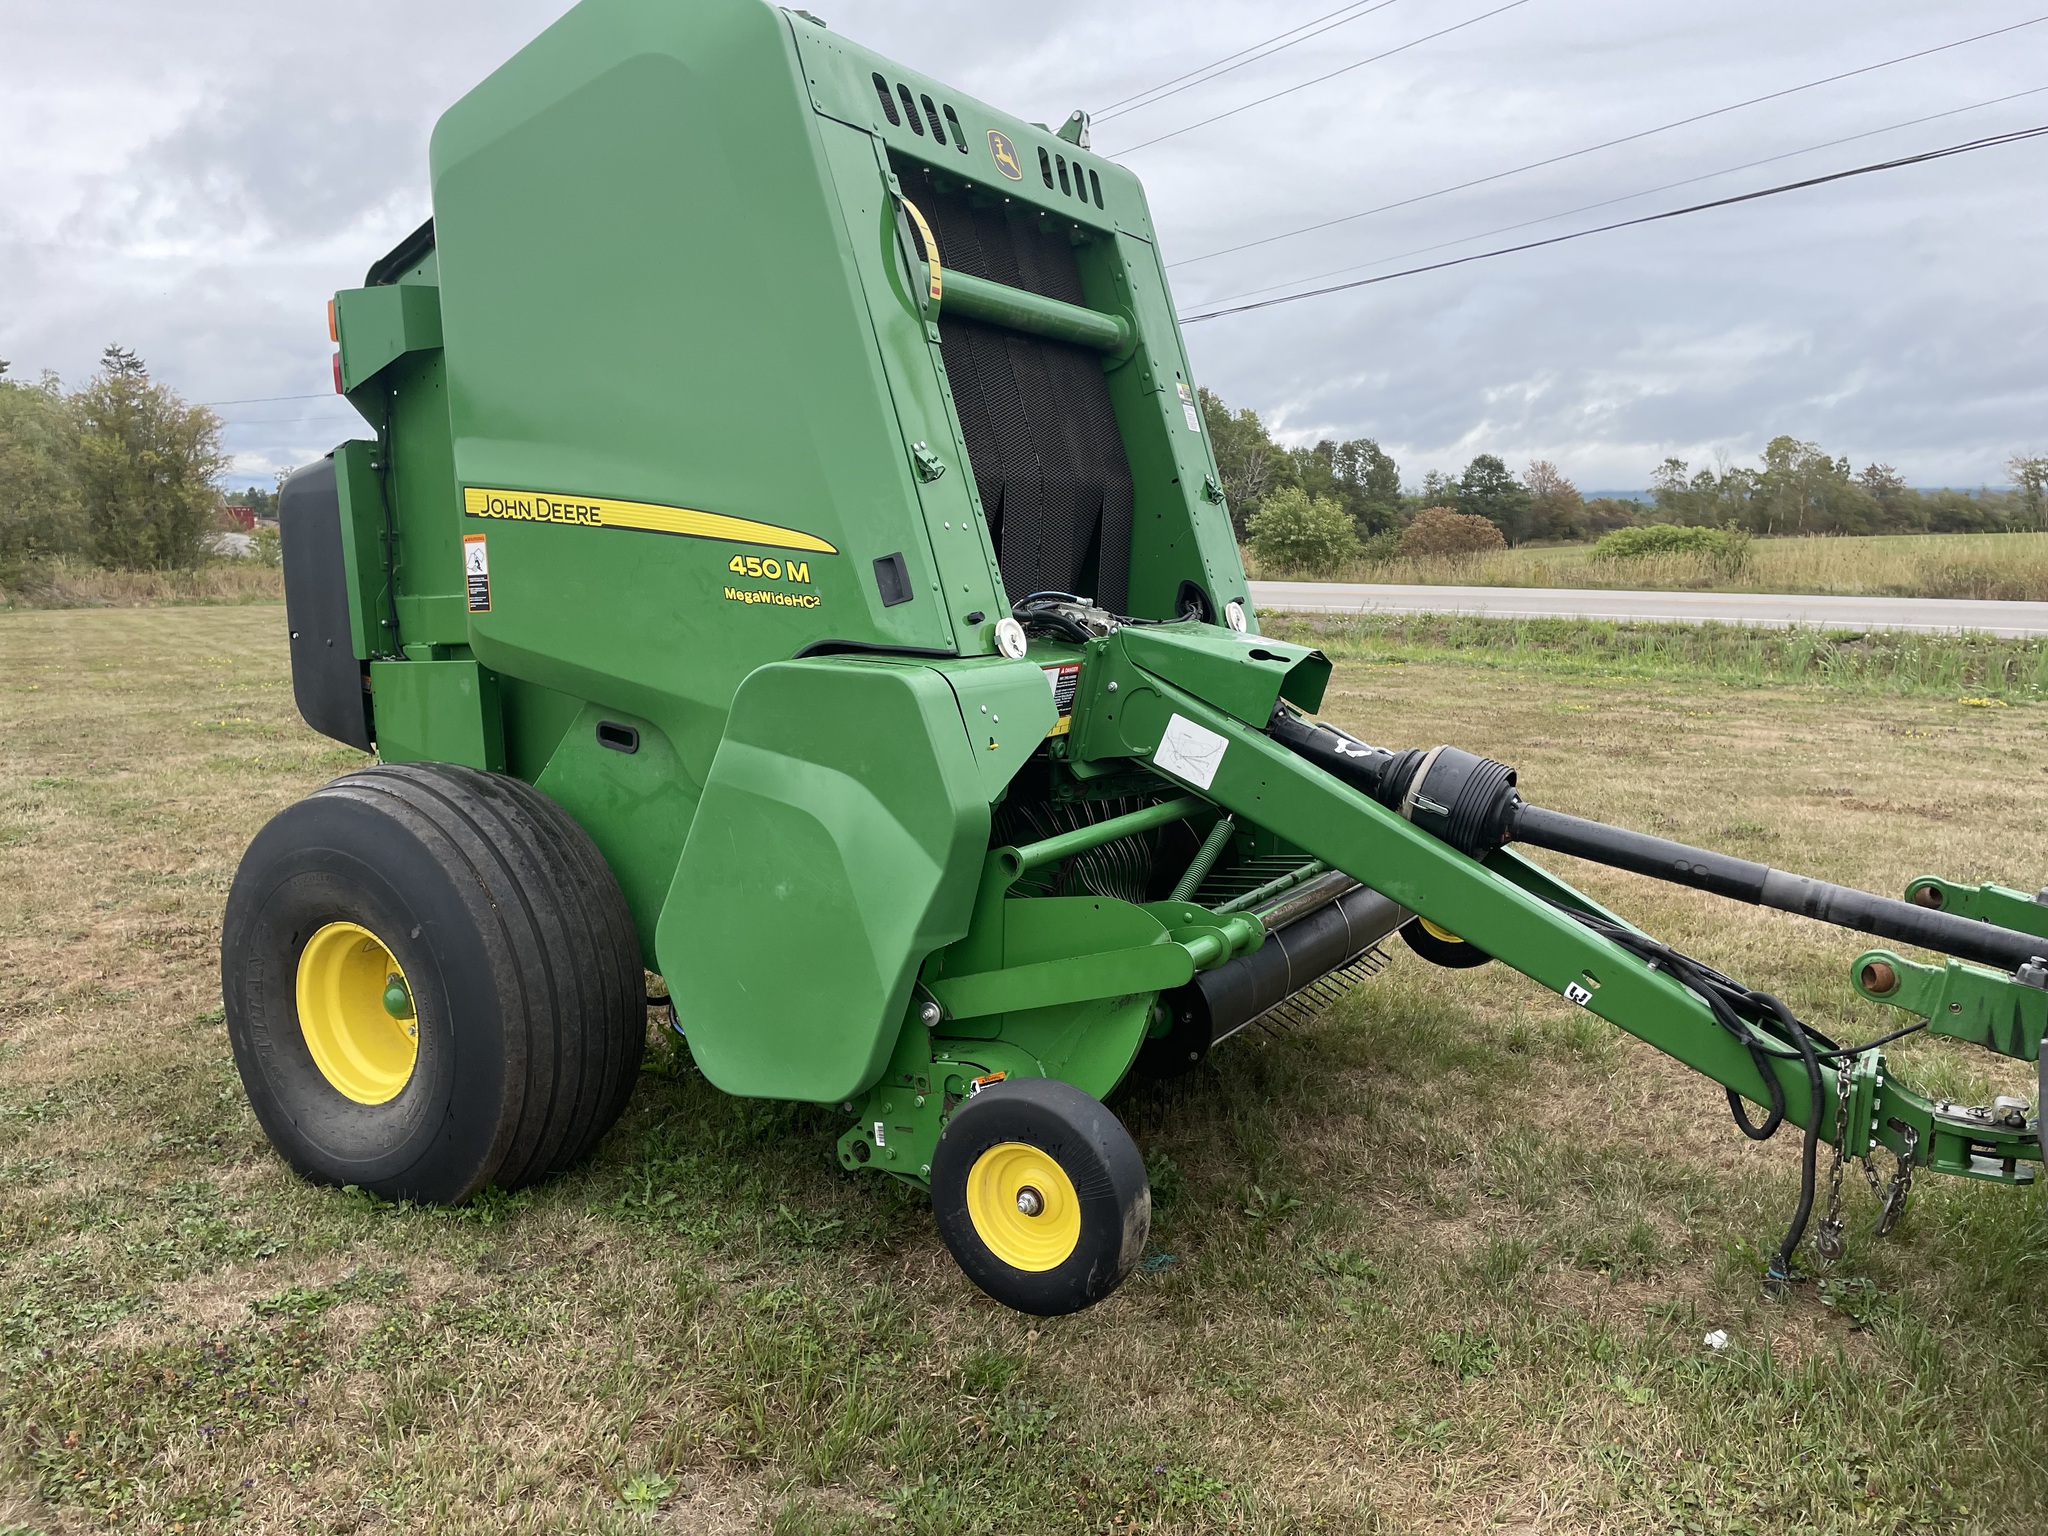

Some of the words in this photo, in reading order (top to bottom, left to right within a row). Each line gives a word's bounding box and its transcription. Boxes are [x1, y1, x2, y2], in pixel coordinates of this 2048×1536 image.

[480, 494, 531, 517] JOHN
[536, 498, 601, 523] DEERE
[728, 554, 782, 580] 450
[785, 560, 811, 584] M
